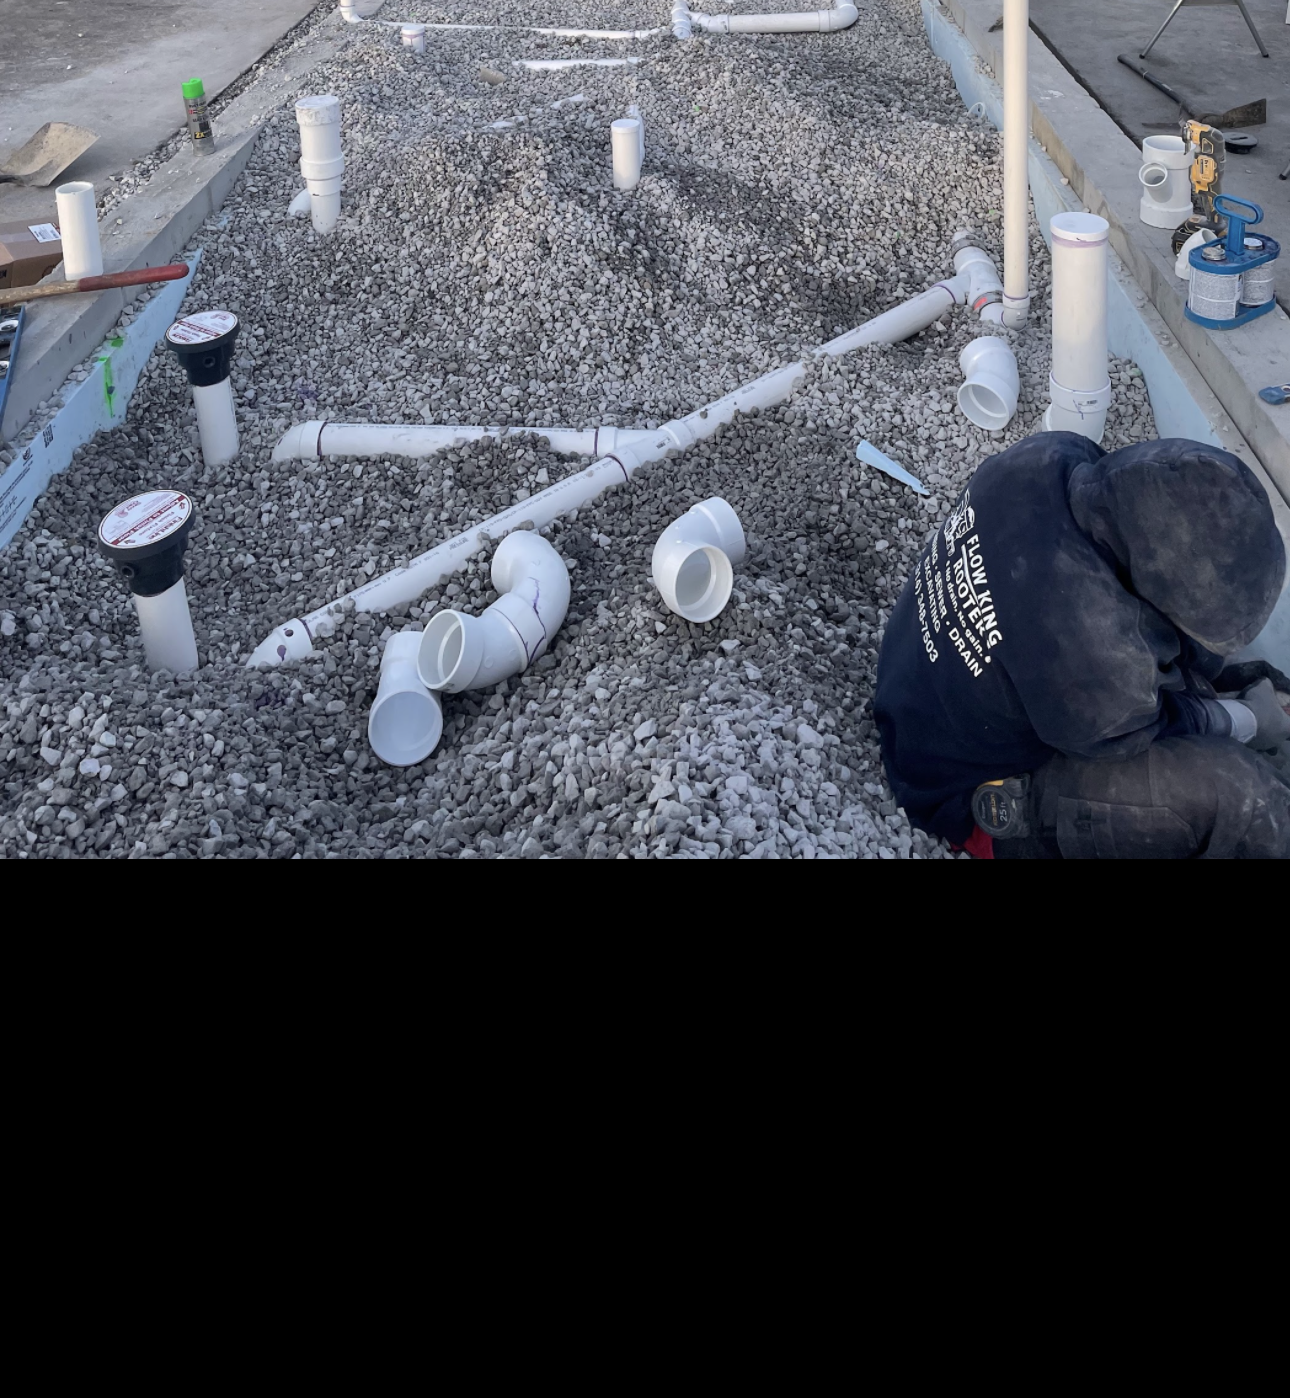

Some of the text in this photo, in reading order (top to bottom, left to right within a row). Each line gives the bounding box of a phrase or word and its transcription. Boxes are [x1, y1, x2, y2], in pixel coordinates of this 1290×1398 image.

[917, 593, 939, 663] 348-7503
[923, 555, 941, 634] EXCAVATING
[934, 570, 948, 620] SEWER
[948, 627, 983, 678] DRAIN
[945, 566, 983, 658] No drain. No gain.
[966, 533, 1003, 649] FLOW KING
[999, 808, 1008, 822] 25
